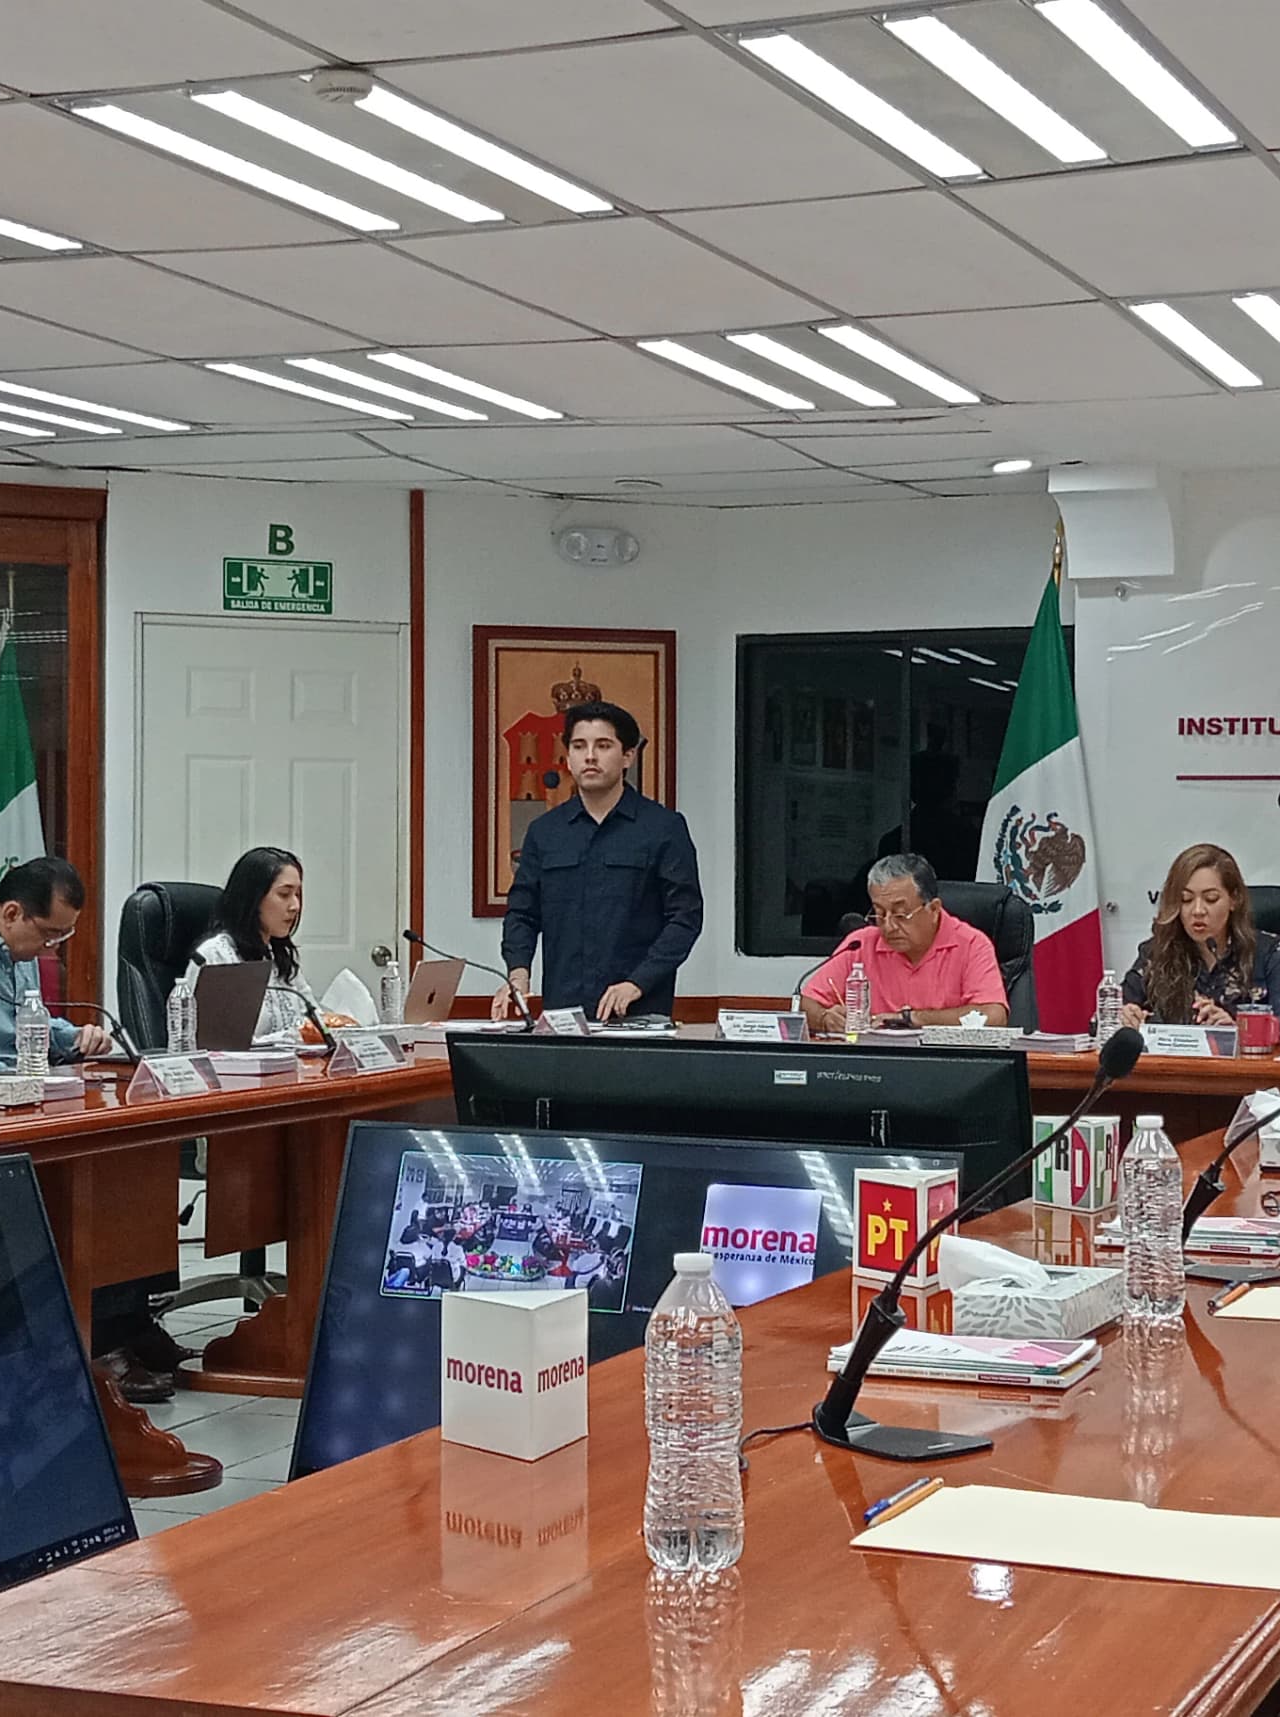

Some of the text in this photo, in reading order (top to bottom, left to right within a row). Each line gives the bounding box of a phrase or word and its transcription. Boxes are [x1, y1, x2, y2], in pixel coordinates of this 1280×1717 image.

[269, 524, 294, 555] B
[231, 600, 325, 612] SALIDA DE EMERGENCIA
[703, 1227, 816, 1253] morena
[868, 1214, 908, 1260] PT
[765, 1253, 776, 1263] de
[447, 1356, 522, 1393] morena
[537, 1356, 584, 1393] morena
